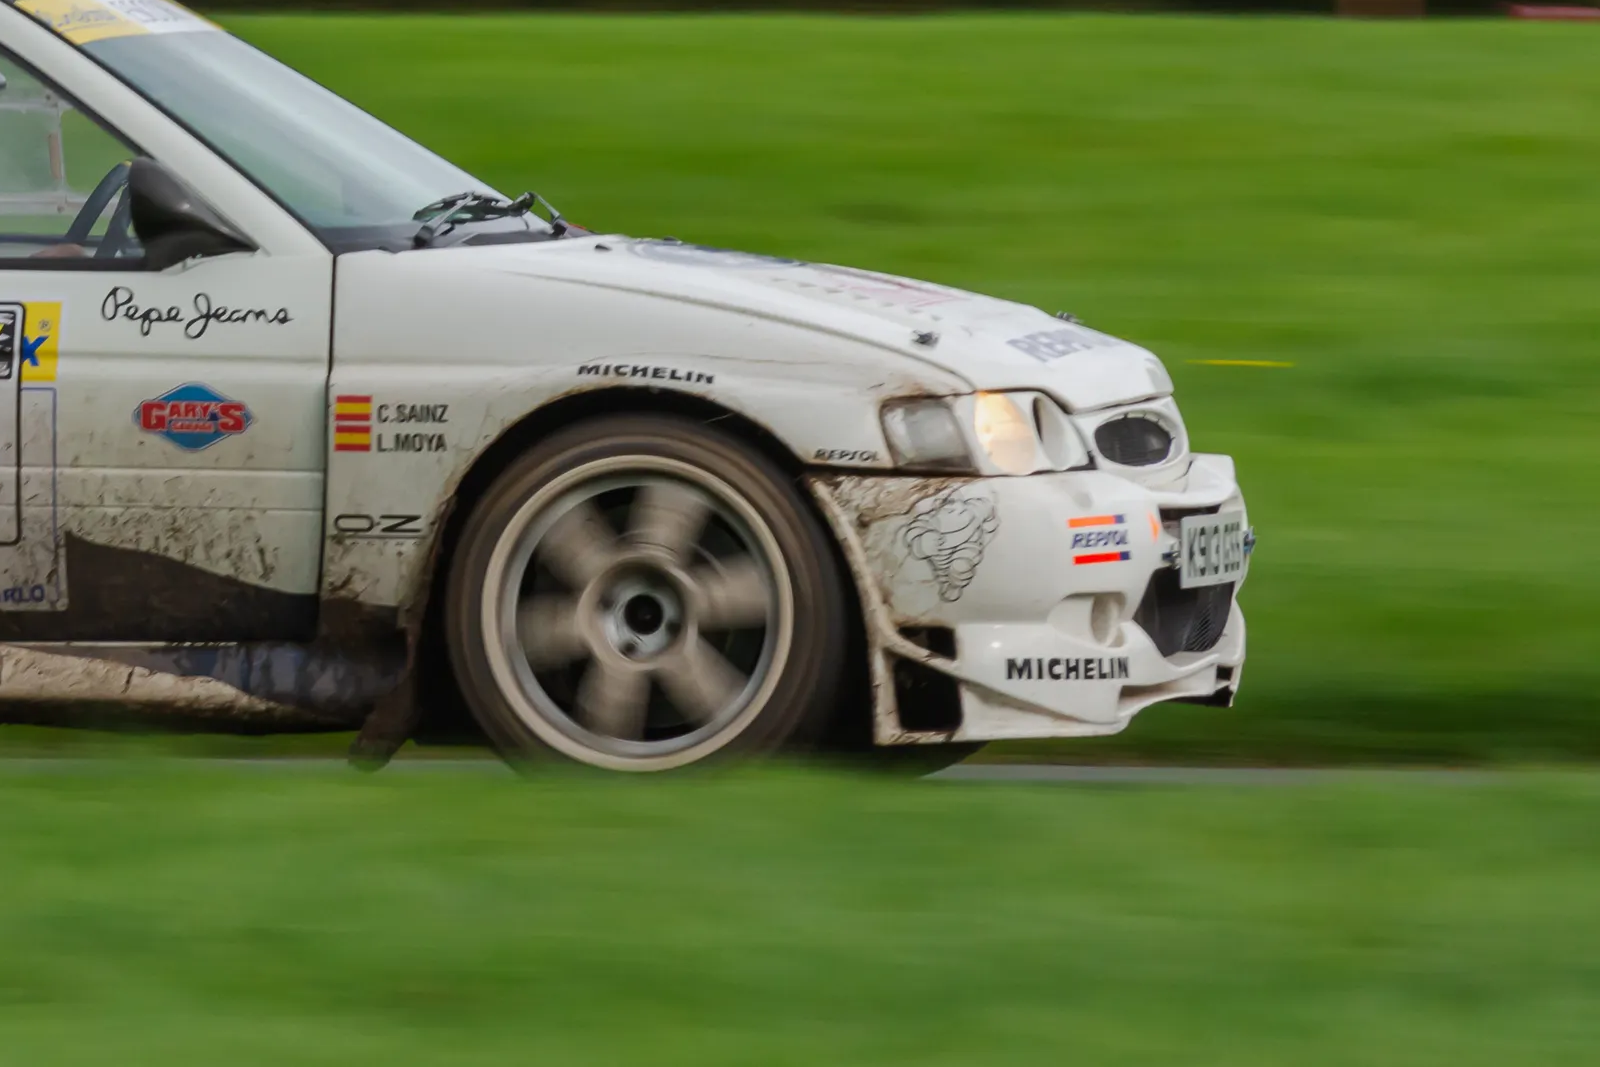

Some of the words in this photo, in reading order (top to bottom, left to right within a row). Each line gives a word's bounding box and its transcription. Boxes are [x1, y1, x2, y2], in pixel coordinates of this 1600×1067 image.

[101, 286, 184, 336] Pepe
[184, 292, 295, 339] Jeans
[576, 364, 716, 385] MICHELIN
[376, 404, 449, 424] C.SAINZ
[376, 433, 448, 453] L.MOYA
[1005, 657, 1130, 680] MICHELIN
